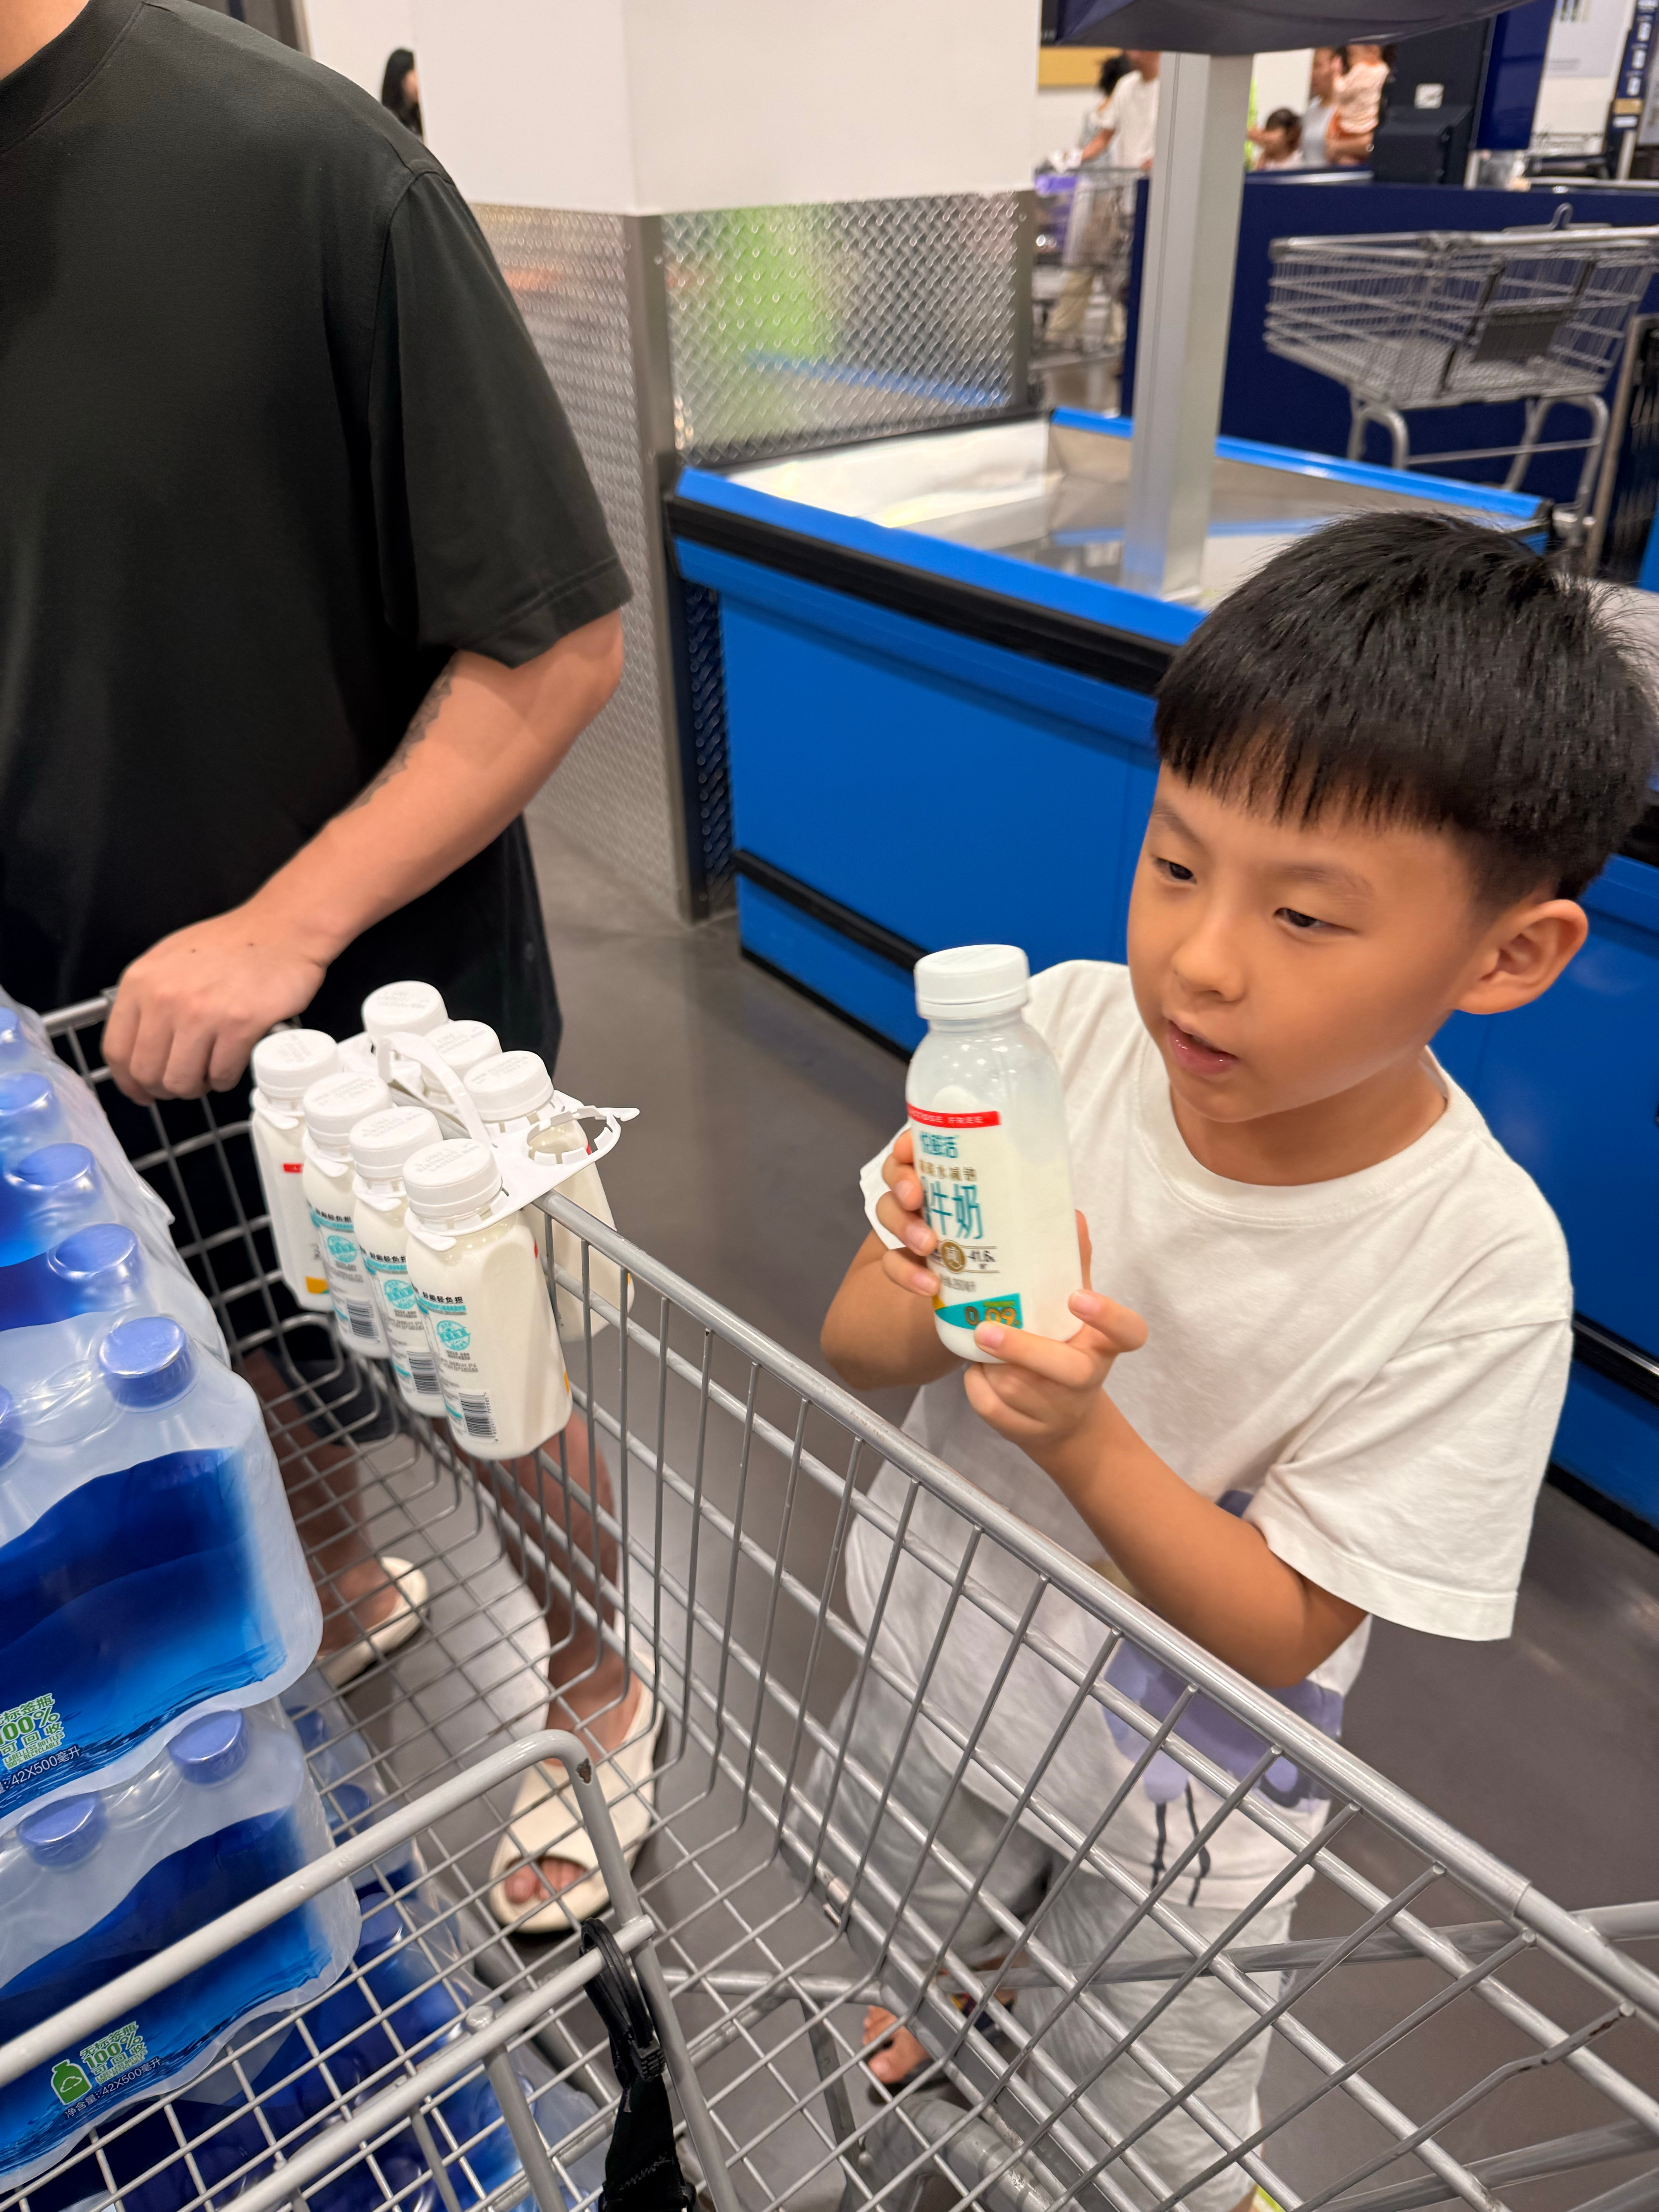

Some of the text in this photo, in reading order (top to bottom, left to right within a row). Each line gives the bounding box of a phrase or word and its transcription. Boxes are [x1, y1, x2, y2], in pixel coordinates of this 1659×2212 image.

[922, 1176, 984, 1239] 牛奶
[4, 1732, 64, 1763] LABELLESS BOTTLES
[24, 1740, 60, 1760] RECYCLABLE
[83, 2032, 143, 2069] 100%
[92, 2042, 146, 2075] 可回收
